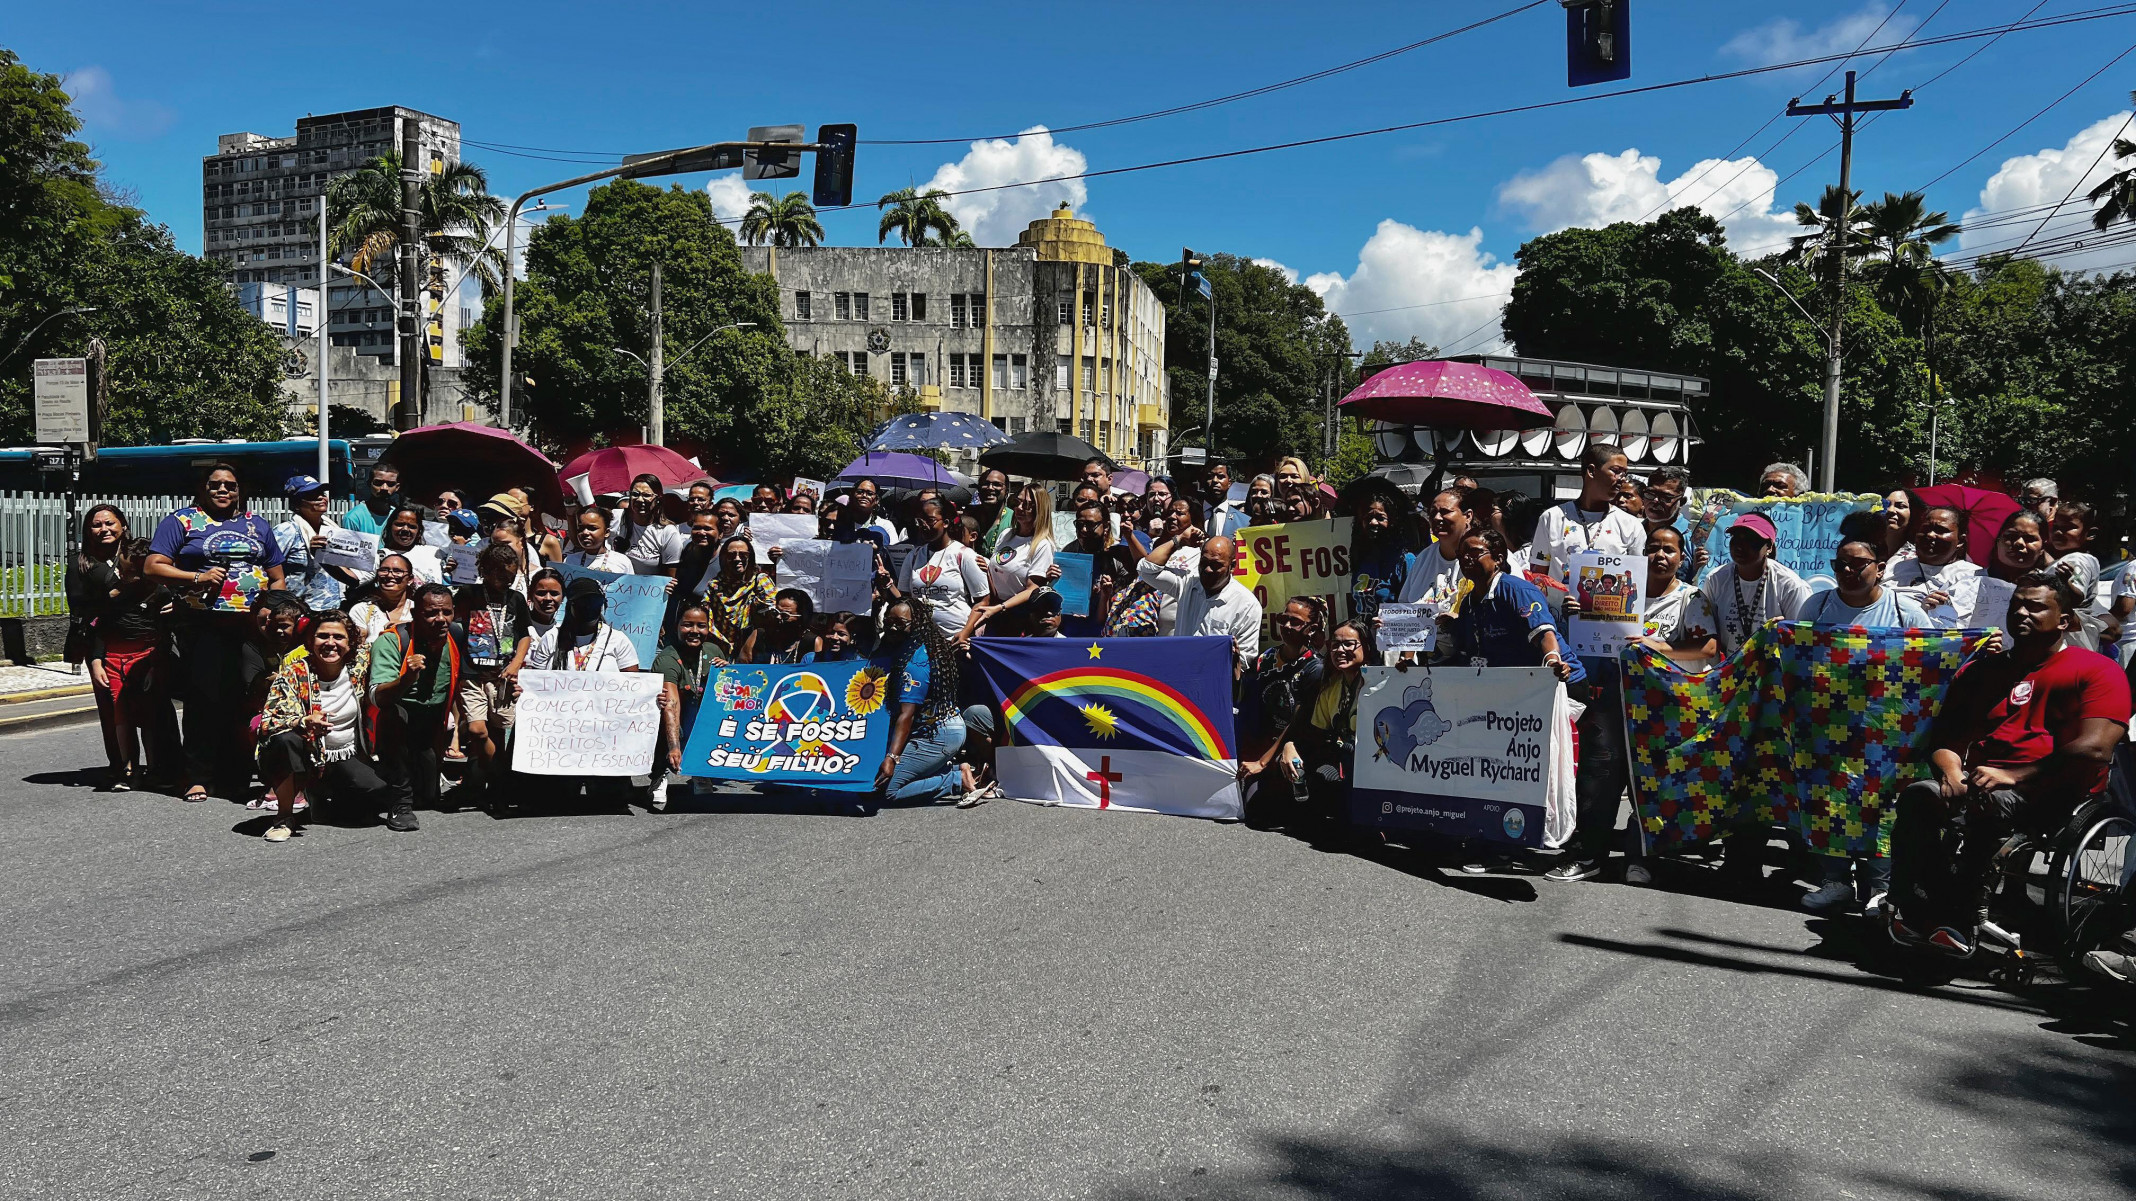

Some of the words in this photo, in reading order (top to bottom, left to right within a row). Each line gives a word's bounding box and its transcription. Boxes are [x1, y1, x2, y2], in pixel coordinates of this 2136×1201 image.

[1802, 503, 1837, 532] BPC
[1253, 534, 1293, 575] SE
[1300, 544, 1352, 580] FOS
[1597, 556, 1622, 566] BPC
[638, 585, 662, 598] NO
[1416, 607, 1432, 618] BPC
[521, 698, 595, 714] COMEÇA
[605, 698, 650, 714] PELO
[723, 698, 764, 711] AMOR
[626, 720, 657, 734] AOS
[718, 718, 739, 739] E
[744, 721, 780, 742] SE
[784, 718, 868, 743] FOSSE
[1486, 710, 1543, 737] Projeto
[526, 750, 572, 768] BPC
[1506, 737, 1541, 764] Anjo
[706, 748, 763, 770] SEU
[766, 753, 861, 774] FILHO?
[1410, 753, 1475, 780] Myguel
[1480, 758, 1541, 784] Rychard
[1395, 804, 1466, 820] @projeto.anjo_miguel
[1483, 804, 1500, 813] APOIO
